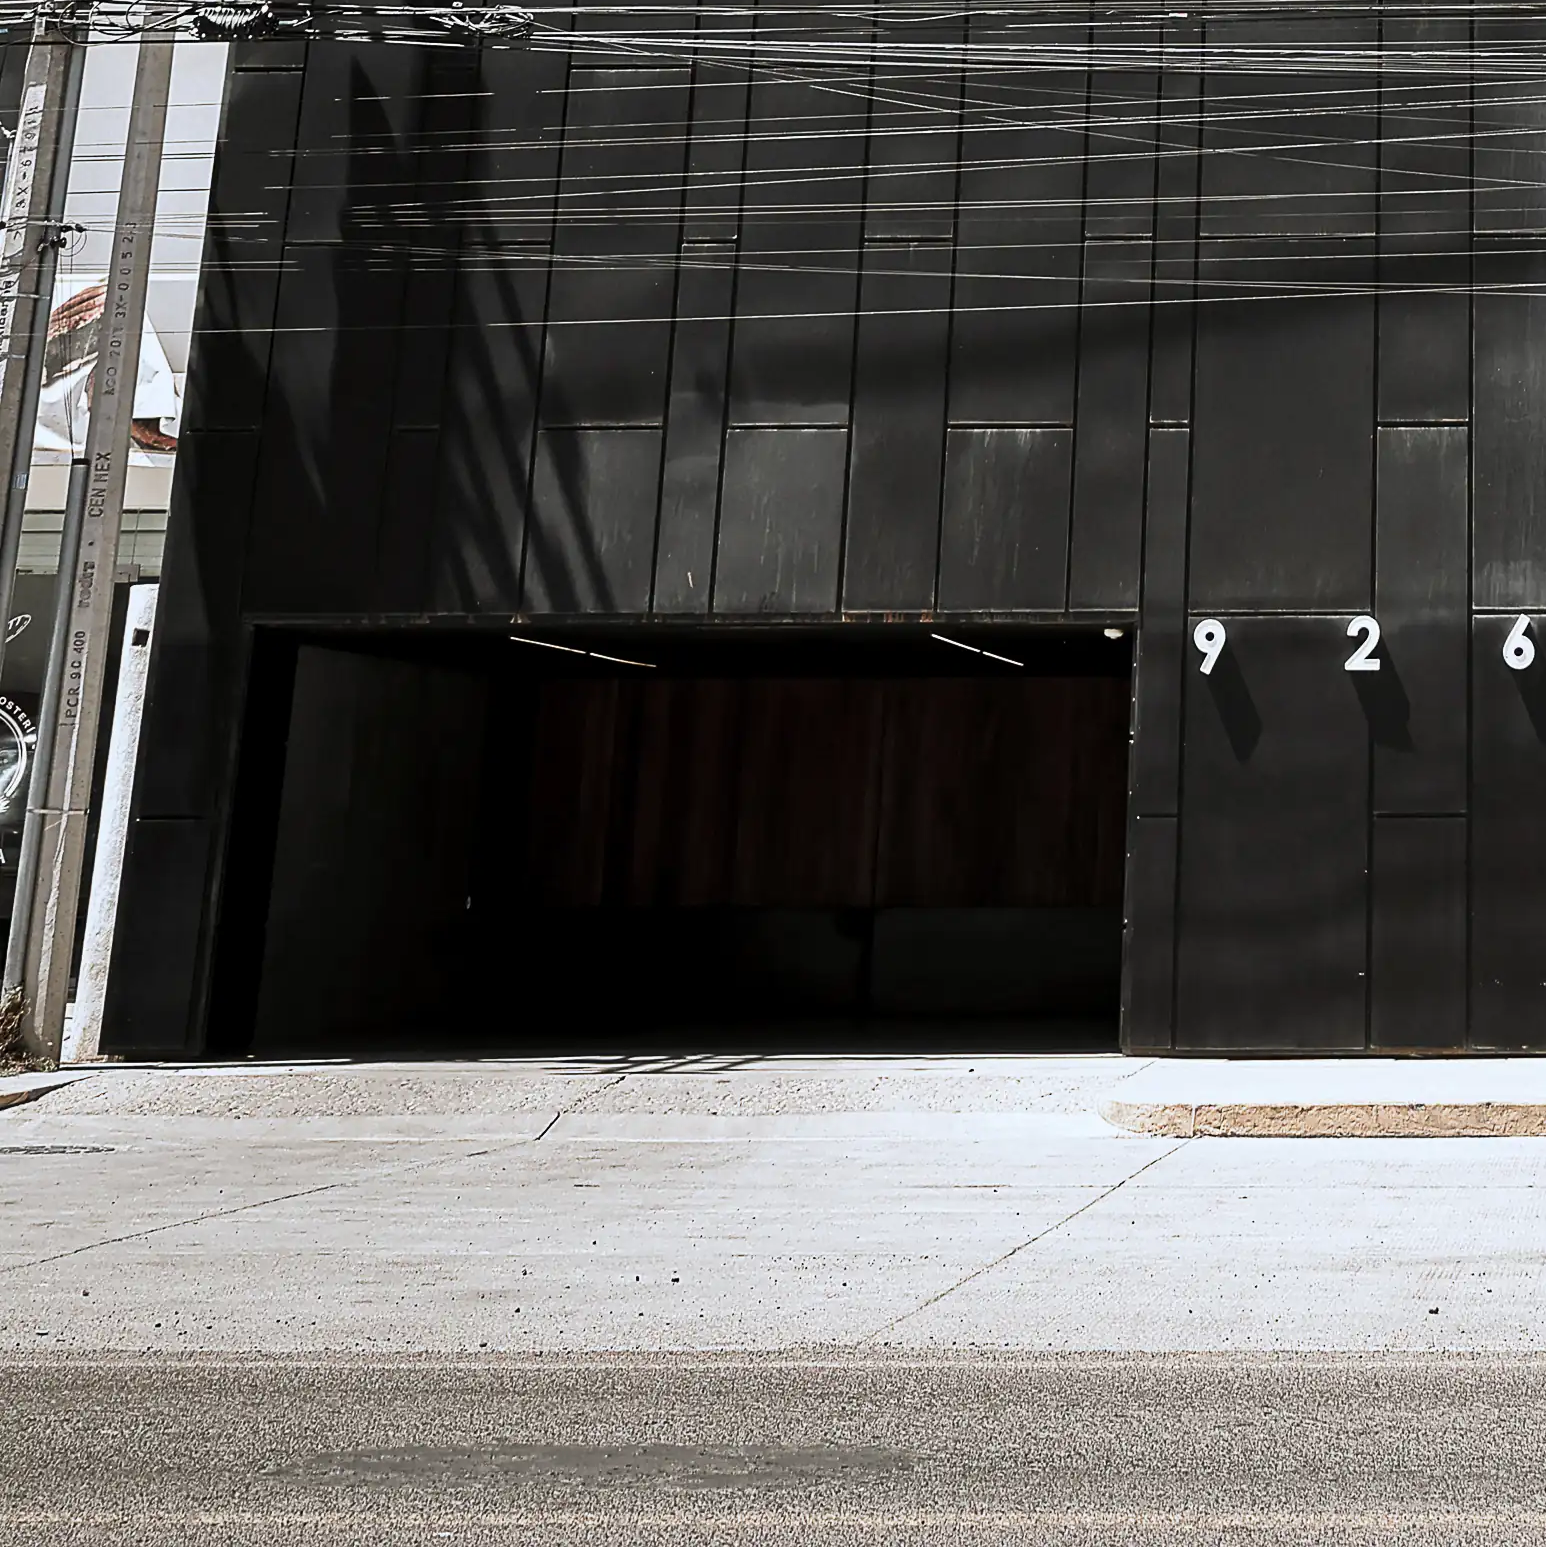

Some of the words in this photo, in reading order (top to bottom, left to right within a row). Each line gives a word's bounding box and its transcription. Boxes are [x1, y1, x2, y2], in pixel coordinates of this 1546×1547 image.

[88, 484, 106, 518] CEN
[65, 686, 81, 719] PCR
[73, 630, 86, 655] 400
